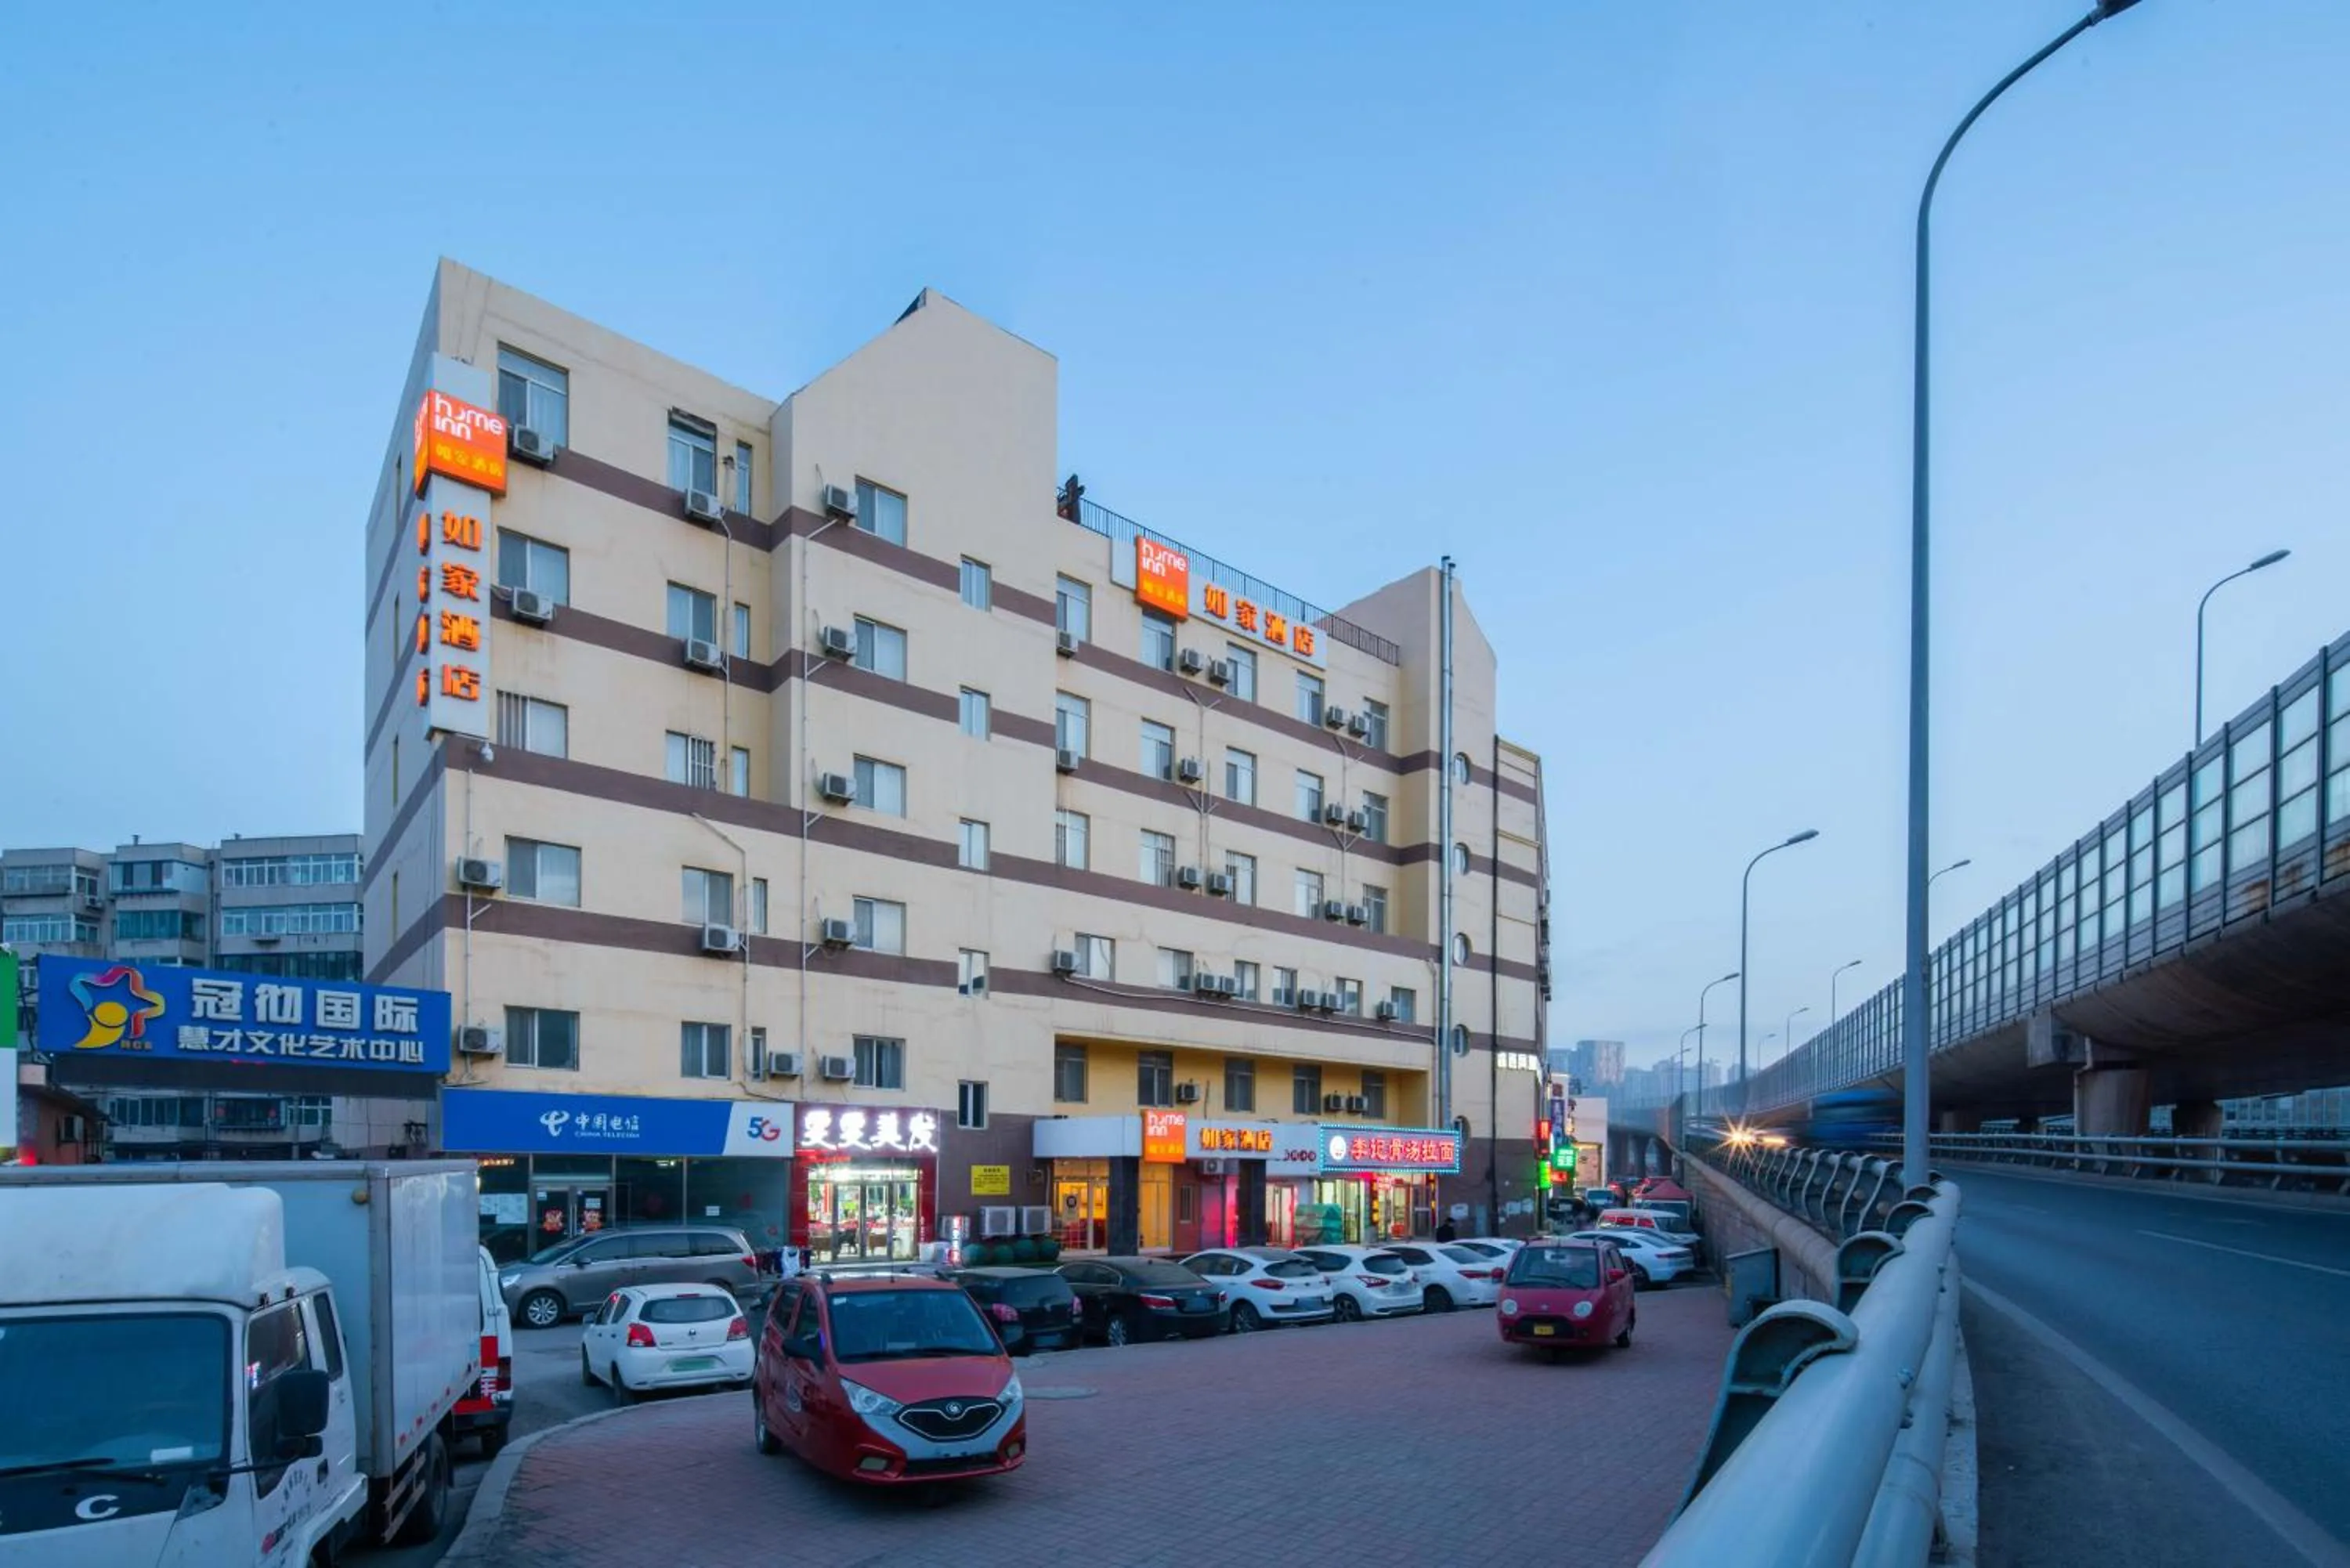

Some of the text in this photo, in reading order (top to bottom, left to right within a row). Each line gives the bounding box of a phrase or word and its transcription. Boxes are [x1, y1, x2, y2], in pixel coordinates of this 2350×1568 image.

[434, 414, 472, 441] inn
[441, 510, 483, 702] 如家酒店
[1203, 583, 1314, 656] 如家酒店
[192, 977, 418, 1032] 冠彻国际
[178, 1025, 424, 1063] 慧才文化艺术中心
[574, 1111, 640, 1131] 中国电信
[747, 1116, 781, 1141] 5G
[1200, 1126, 1274, 1151] 如家酒店
